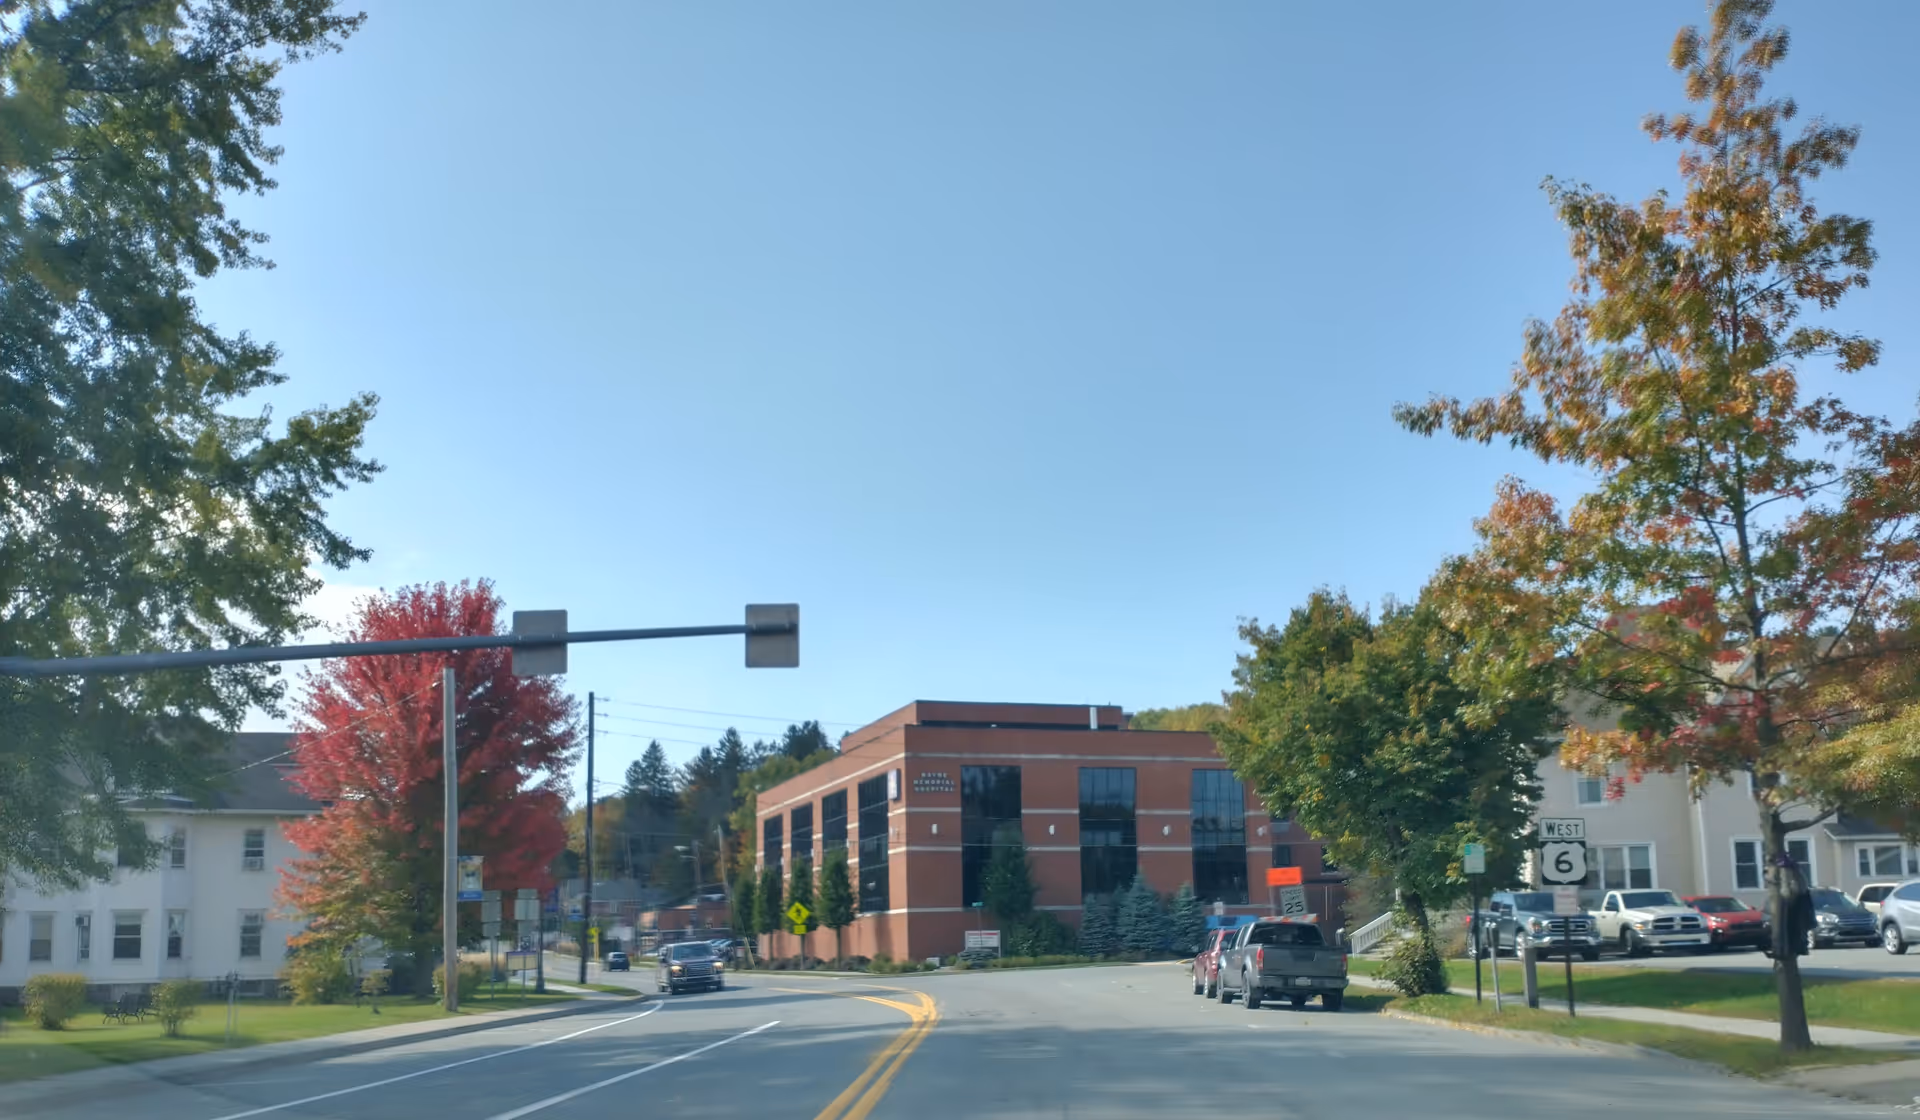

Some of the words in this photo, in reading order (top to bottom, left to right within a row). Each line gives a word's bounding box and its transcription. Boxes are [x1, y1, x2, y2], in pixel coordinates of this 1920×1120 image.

[1545, 822, 1580, 836] WEST
[1554, 850, 1574, 874] 6
[1284, 901, 1304, 914] 25
